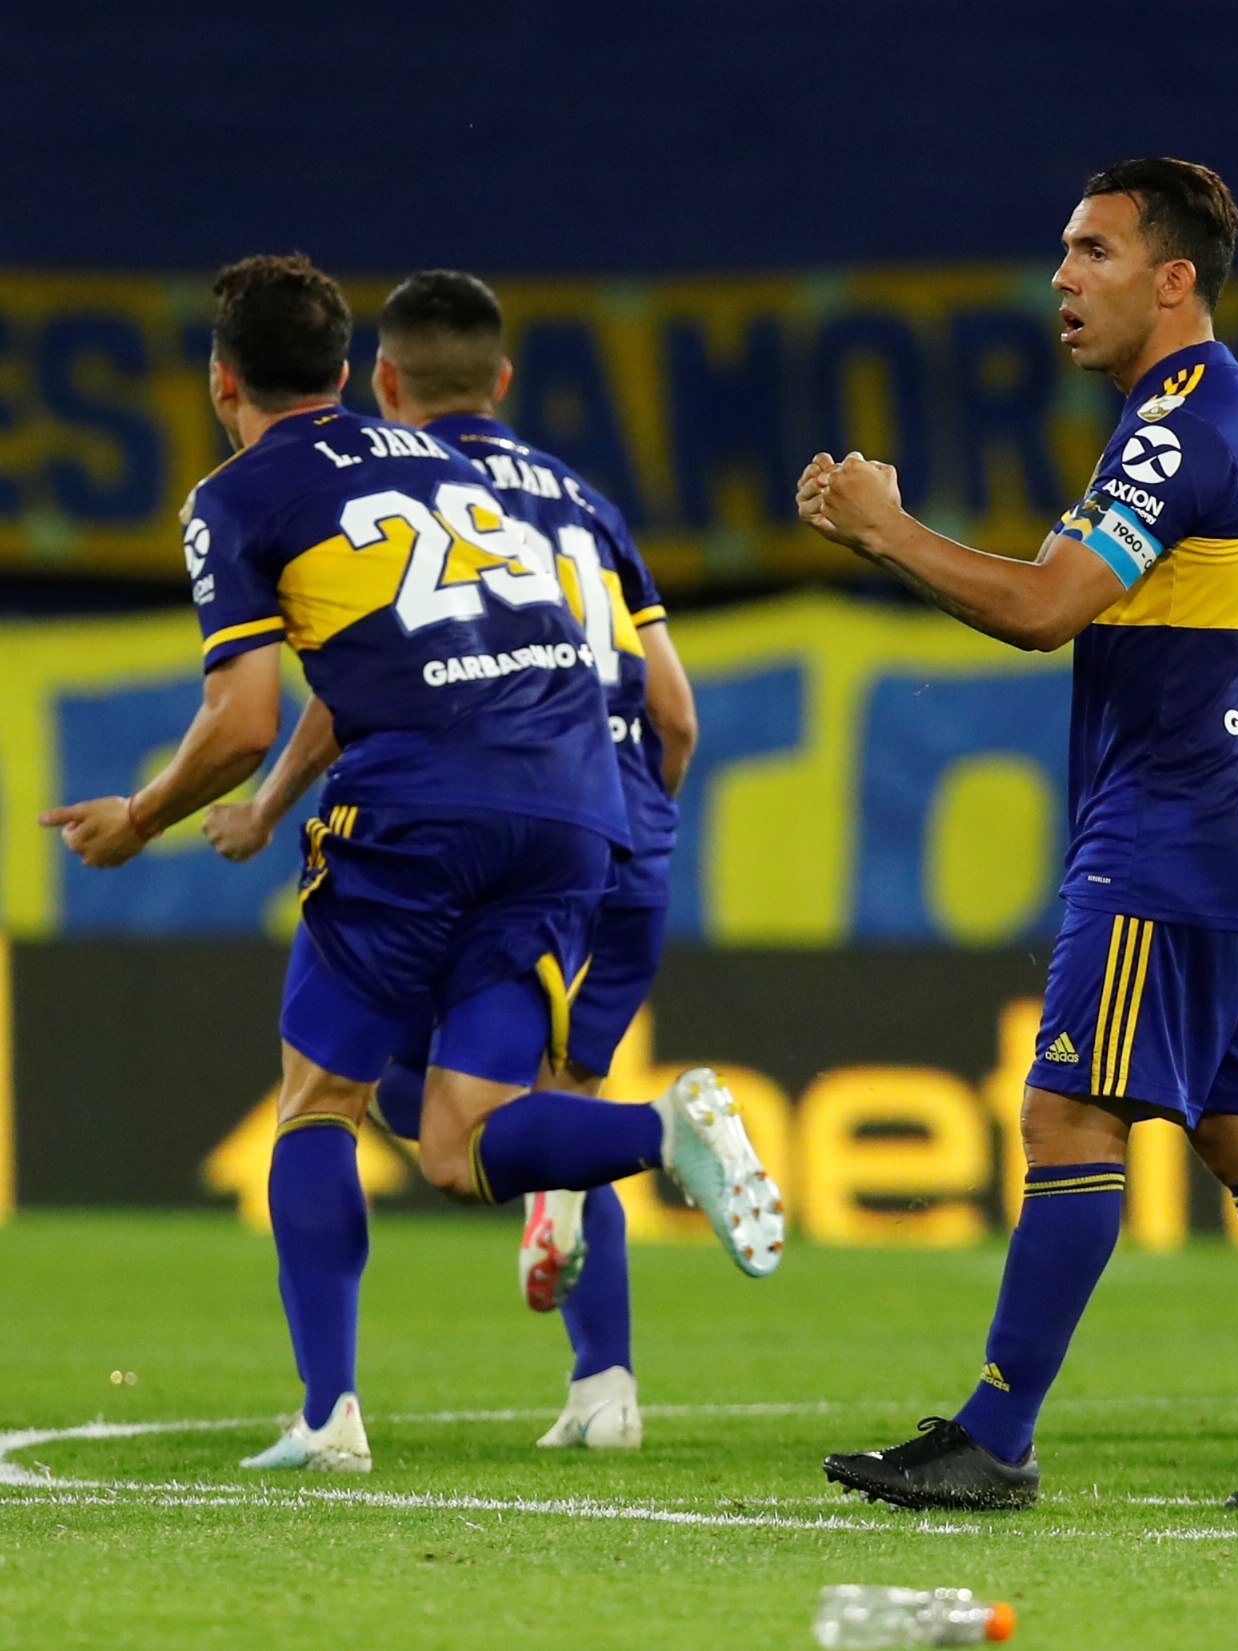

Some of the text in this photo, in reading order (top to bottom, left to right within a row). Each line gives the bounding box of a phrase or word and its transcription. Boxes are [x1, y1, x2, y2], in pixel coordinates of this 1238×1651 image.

[314, 440, 363, 468] L.
[360, 427, 449, 460] JARA
[470, 454, 562, 500] MAN
[1102, 478, 1165, 517] AXION
[1130, 505, 1157, 525] ergy
[1112, 521, 1143, 553] 1960
[339, 483, 564, 634] 29
[1045, 1051, 1080, 1063] adidas
